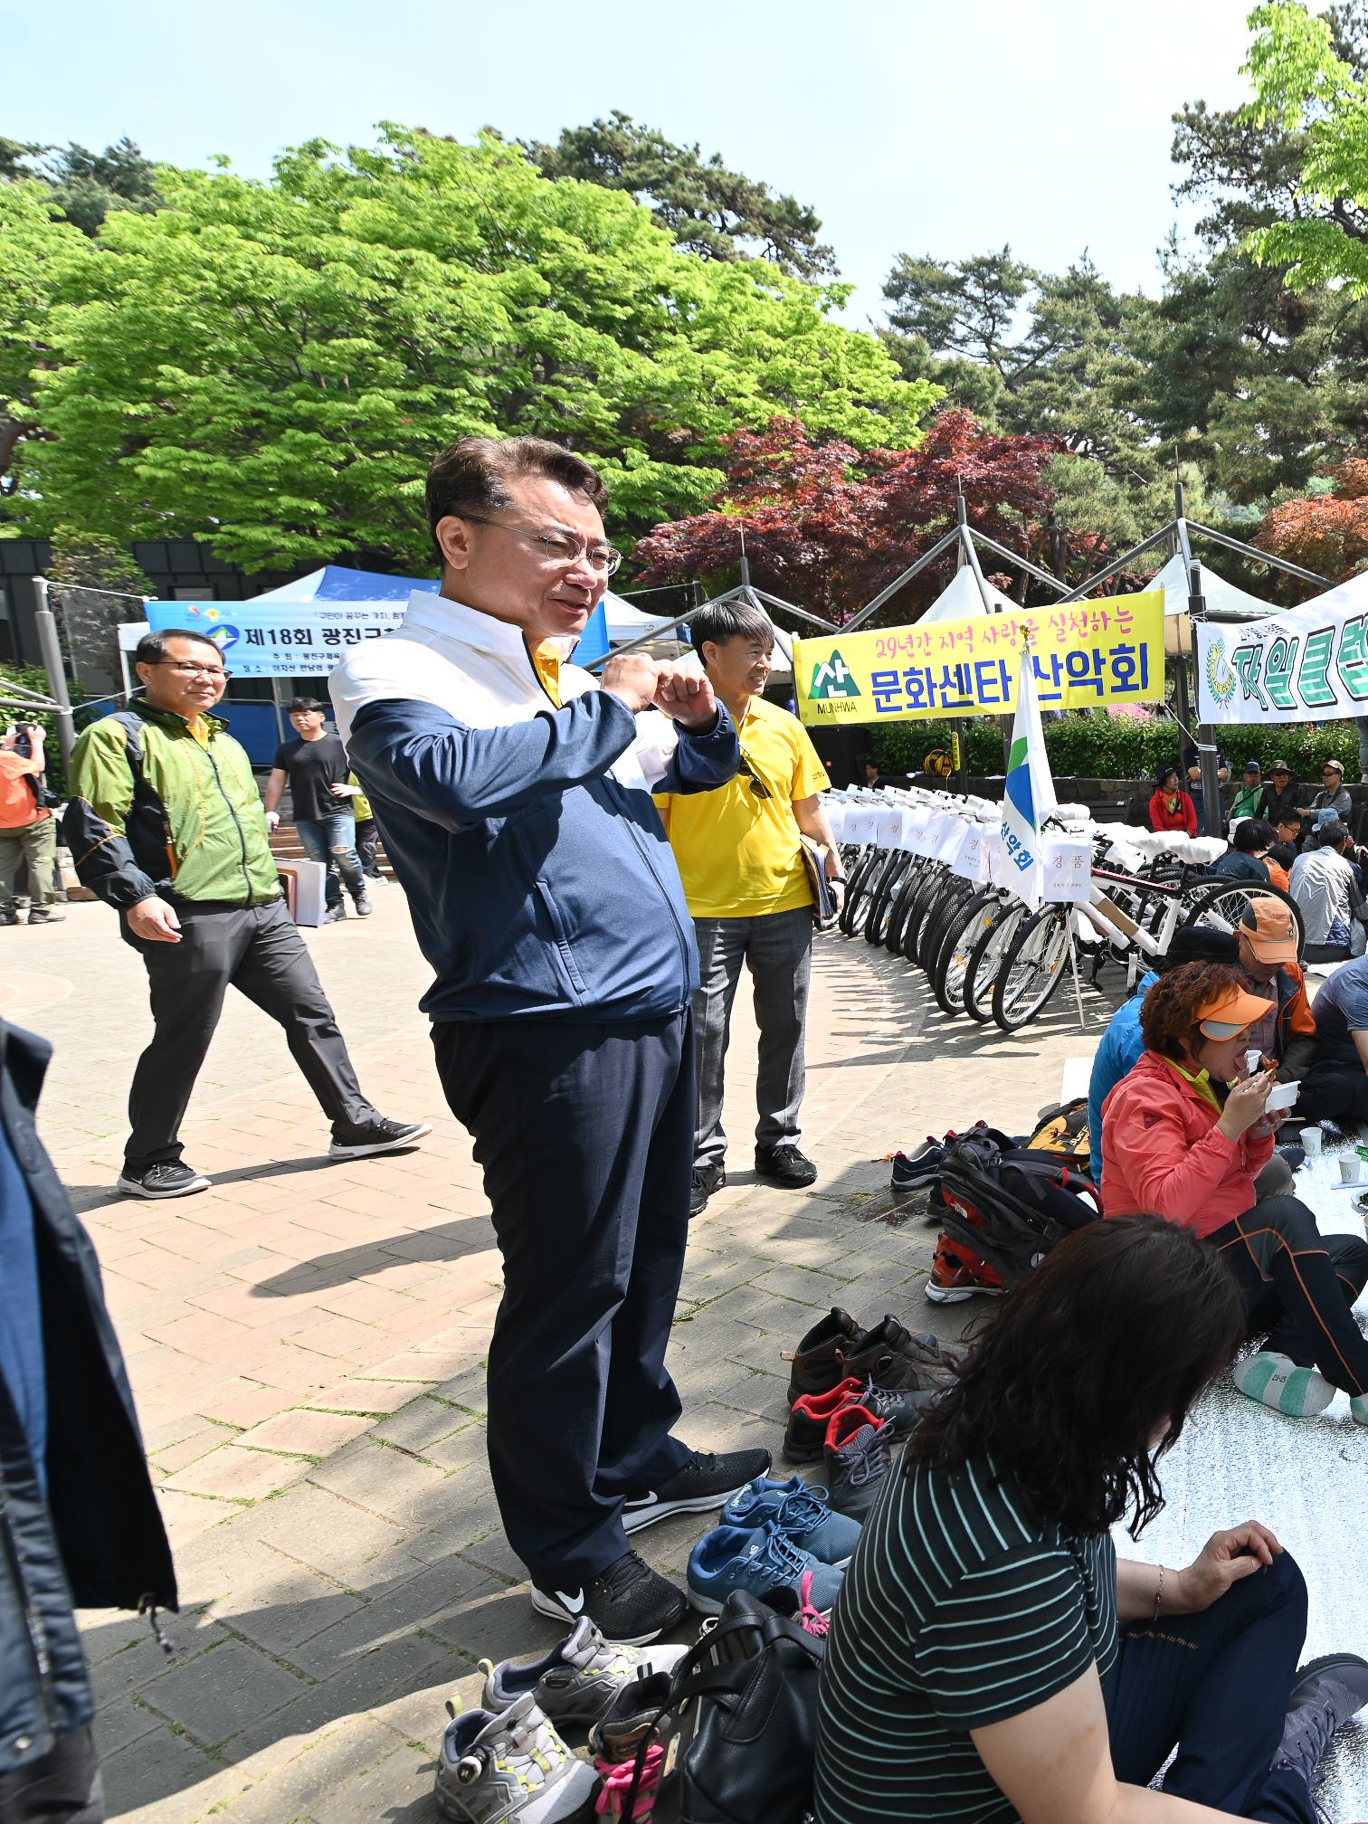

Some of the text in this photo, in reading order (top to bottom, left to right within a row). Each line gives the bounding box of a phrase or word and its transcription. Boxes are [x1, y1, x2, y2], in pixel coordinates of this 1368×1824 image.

[246, 627, 400, 646] 제18회 광진구
[875, 631, 934, 660] 29년간
[939, 625, 975, 653] 지역
[1048, 605, 1134, 643] 실천하는
[814, 660, 850, 698] 산
[870, 658, 1013, 714] 문화센터
[1032, 641, 1150, 701] 산악회
[817, 701, 858, 715] MUNHWA
